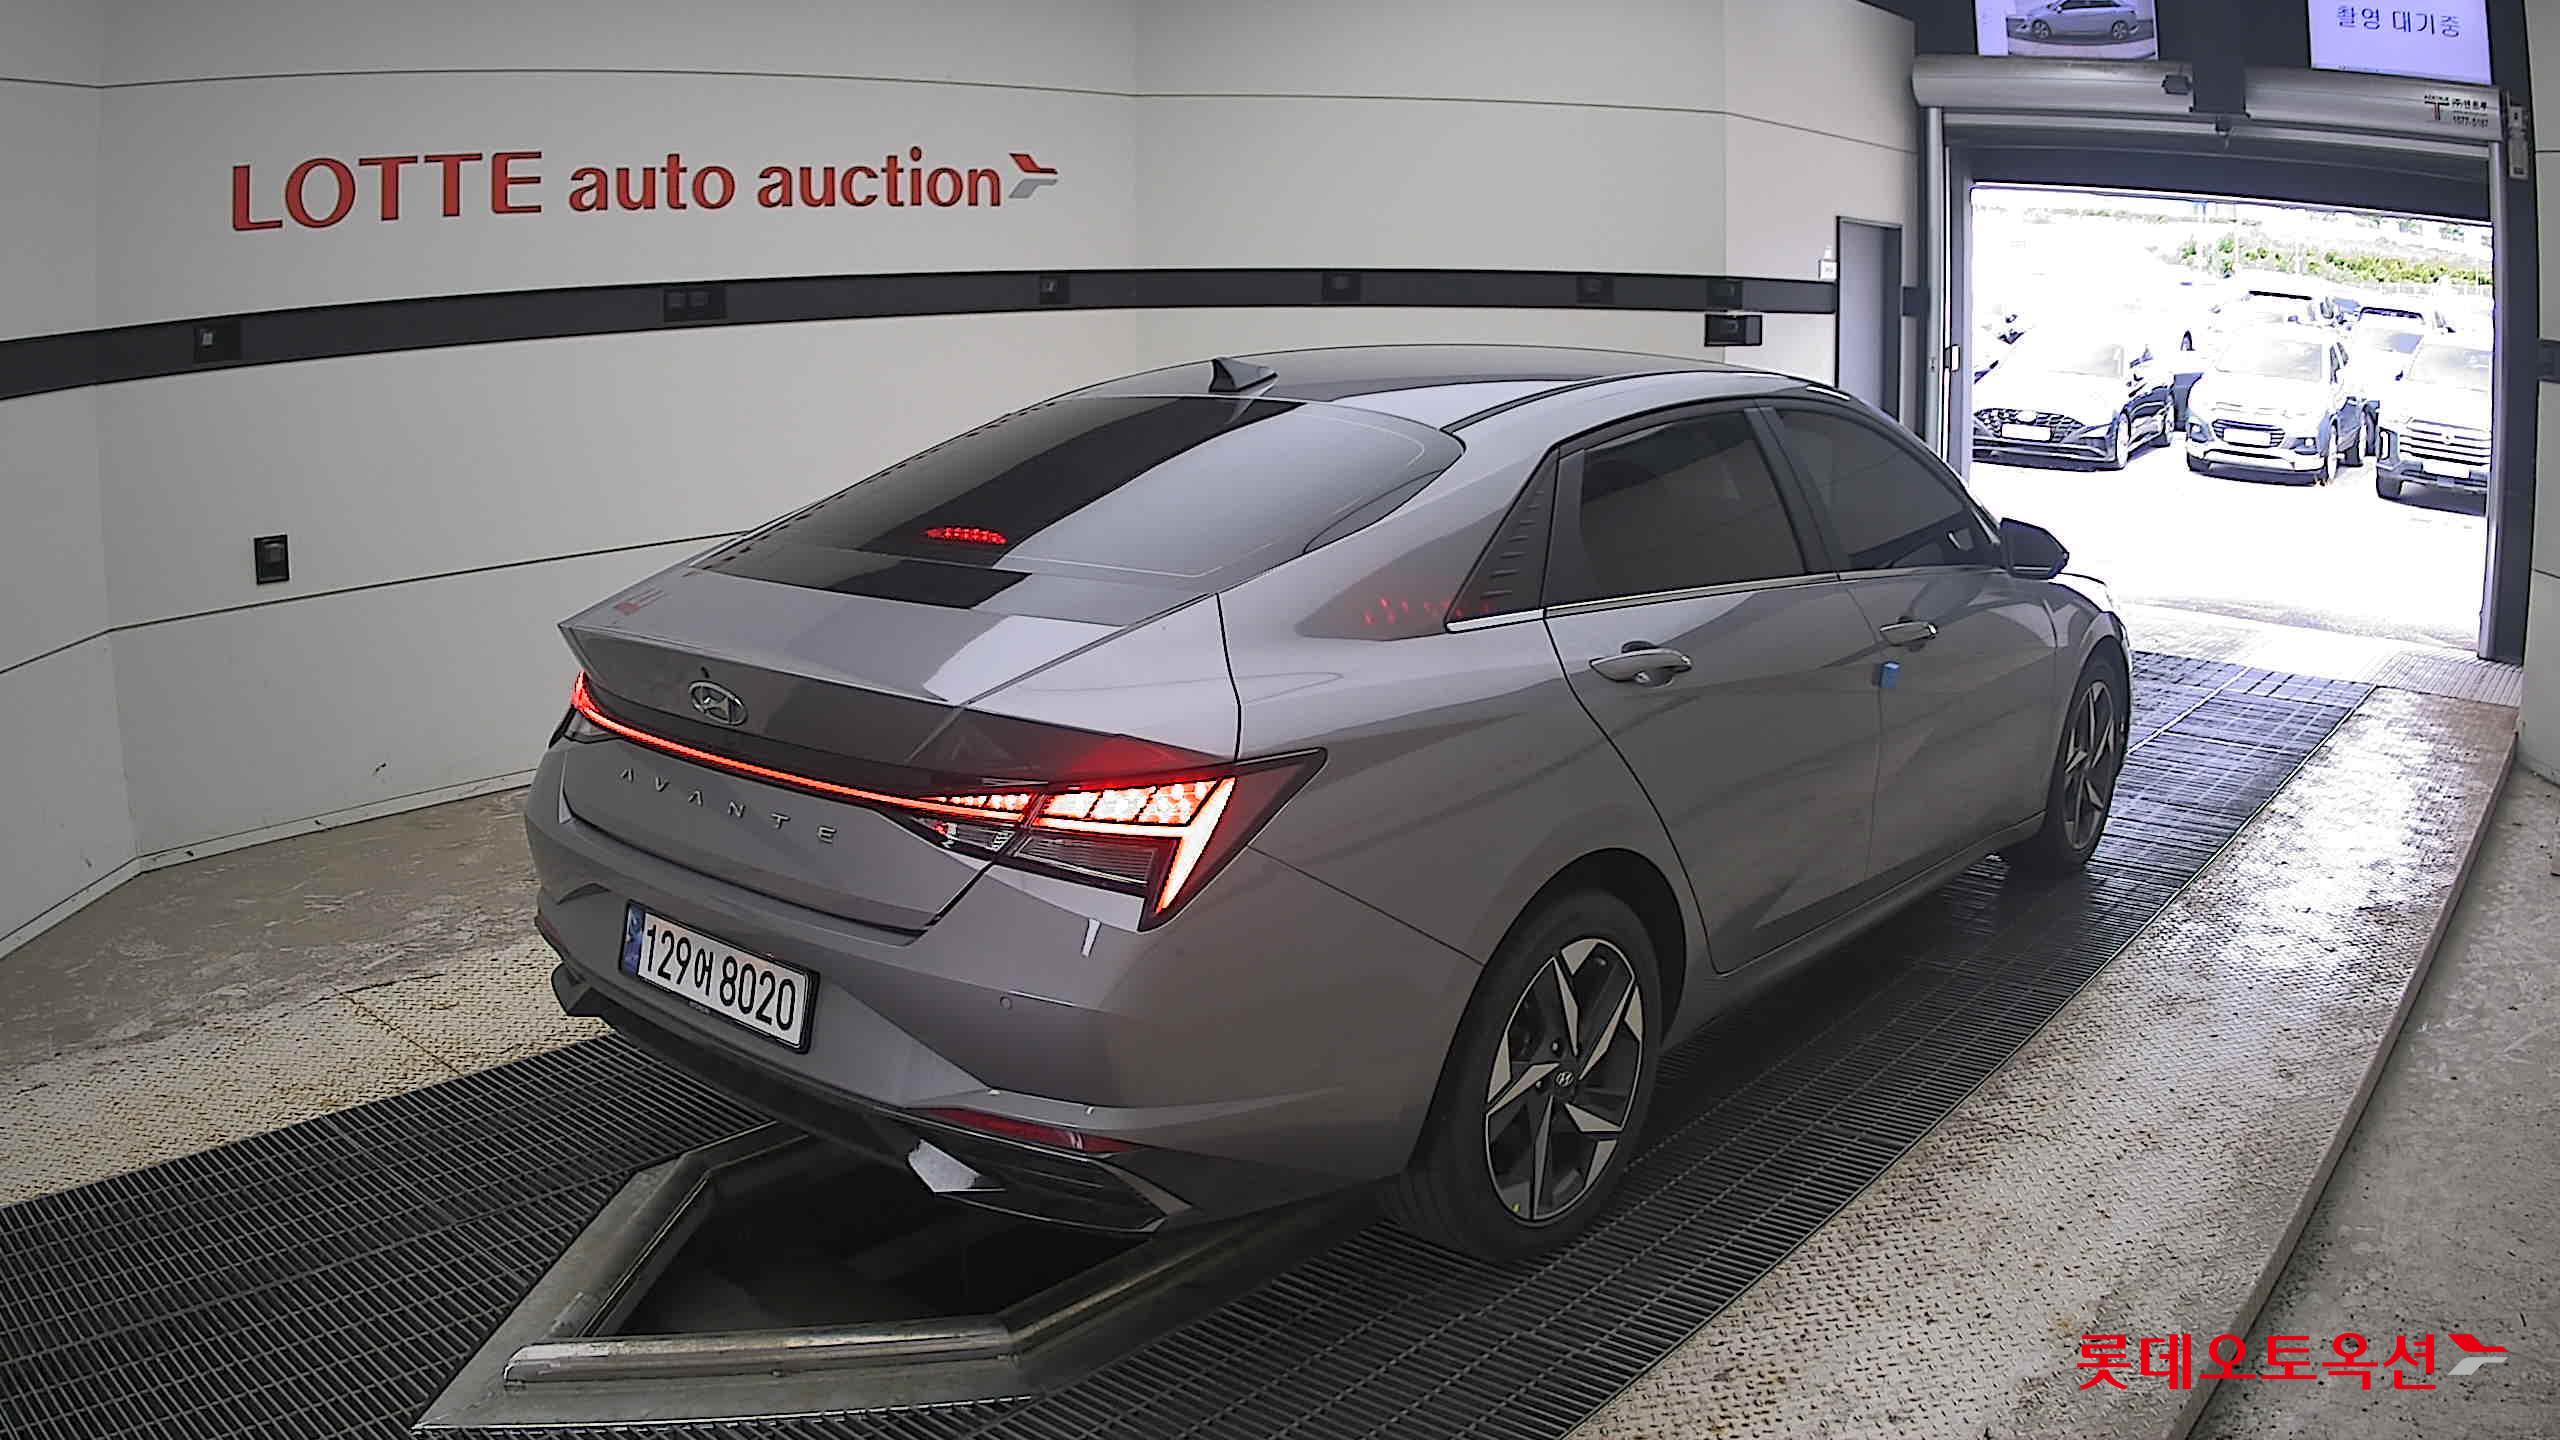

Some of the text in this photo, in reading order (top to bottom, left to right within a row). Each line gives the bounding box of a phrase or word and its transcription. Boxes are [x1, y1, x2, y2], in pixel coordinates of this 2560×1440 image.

[2337, 5, 2460, 38] 촬영 대기중
[232, 146, 1001, 231] LOTTE auto auction
[620, 768, 837, 844] AVANTE
